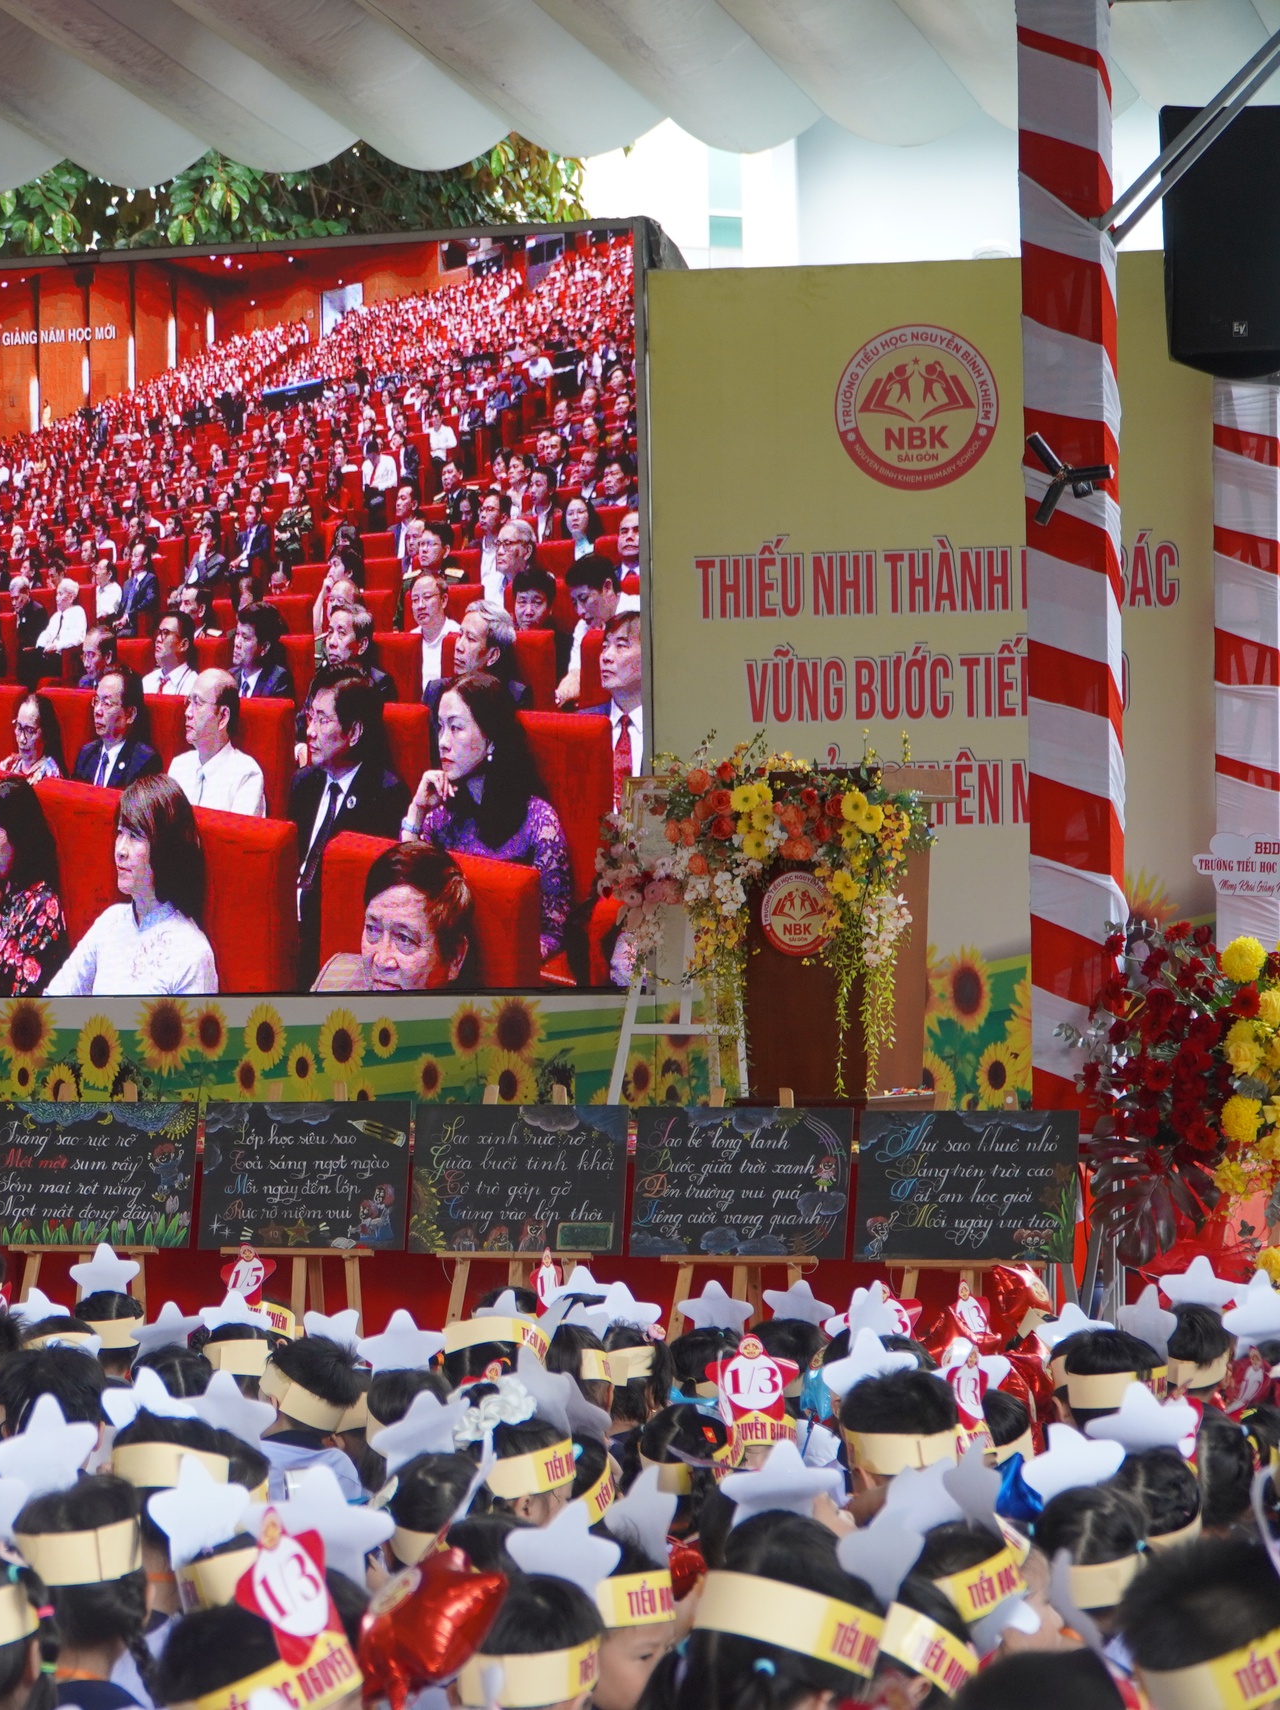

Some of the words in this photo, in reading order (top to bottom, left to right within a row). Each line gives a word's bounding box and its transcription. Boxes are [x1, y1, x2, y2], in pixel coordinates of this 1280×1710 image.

[2, 327, 38, 346] GIẢNG
[40, 326, 65, 344] NĂM
[68, 327, 92, 345] HỌC
[95, 323, 116, 340] MỚI
[841, 371, 860, 427] TRƯỜNG
[880, 333, 908, 349] HỌC
[911, 332, 963, 354] NGUYỄN
[979, 379, 994, 421] KHIÊM
[884, 426, 949, 451] NBK
[897, 453, 914, 463] SÀI
[916, 452, 939, 462] GÒN
[695, 535, 804, 620] THIẾU
[812, 551, 877, 616] NHI
[882, 535, 1013, 614] THÀNH
[744, 642, 847, 723] VỮNG
[854, 642, 954, 720] BƯỚC
[1199, 857, 1234, 872] TRƯỜNG
[1237, 856, 1257, 872] TIỂU
[1259, 861, 1278, 875] HỌC
[782, 923, 812, 936] NBK
[268, 1123, 294, 1148] học
[297, 1132, 328, 1145] siêu
[330, 1133, 357, 1145] sao
[477, 1122, 519, 1145] xinh
[687, 1126, 706, 1148] bé
[711, 1127, 743, 1160] long
[750, 1128, 790, 1150] lanh
[943, 1139, 971, 1152] sao
[1026, 1125, 1060, 1152] nhỏ
[266, 1155, 311, 1179] sáng
[313, 1155, 348, 1180] ngọt
[351, 1154, 390, 1180] ngào
[526, 1146, 568, 1171] tinh
[643, 1148, 695, 1174] Bước
[689, 1159, 733, 1185] giữa
[739, 1159, 767, 1174] trời
[772, 1155, 816, 1175] xanh
[262, 1179, 302, 1204] ngày
[301, 1179, 332, 1195] đến
[335, 1174, 361, 1201] lớp
[475, 1181, 500, 1196] trò
[505, 1182, 541, 1207] gặp
[548, 1181, 573, 1208] gỡ
[684, 1184, 735, 1212] trường
[741, 1186, 766, 1199] vui
[771, 1184, 802, 1209] quá
[282, 1205, 323, 1220] niềm
[326, 1207, 353, 1219] vui
[500, 1207, 527, 1221] vào
[533, 1199, 561, 1229] lớp
[569, 1200, 603, 1221] thôi
[687, 1207, 719, 1225] cười
[722, 1213, 764, 1239] vang
[768, 1203, 823, 1235] quanh
[229, 1266, 263, 1290] 1/5
[727, 1365, 780, 1396] 1/3
[259, 1553, 321, 1619] 1/3
